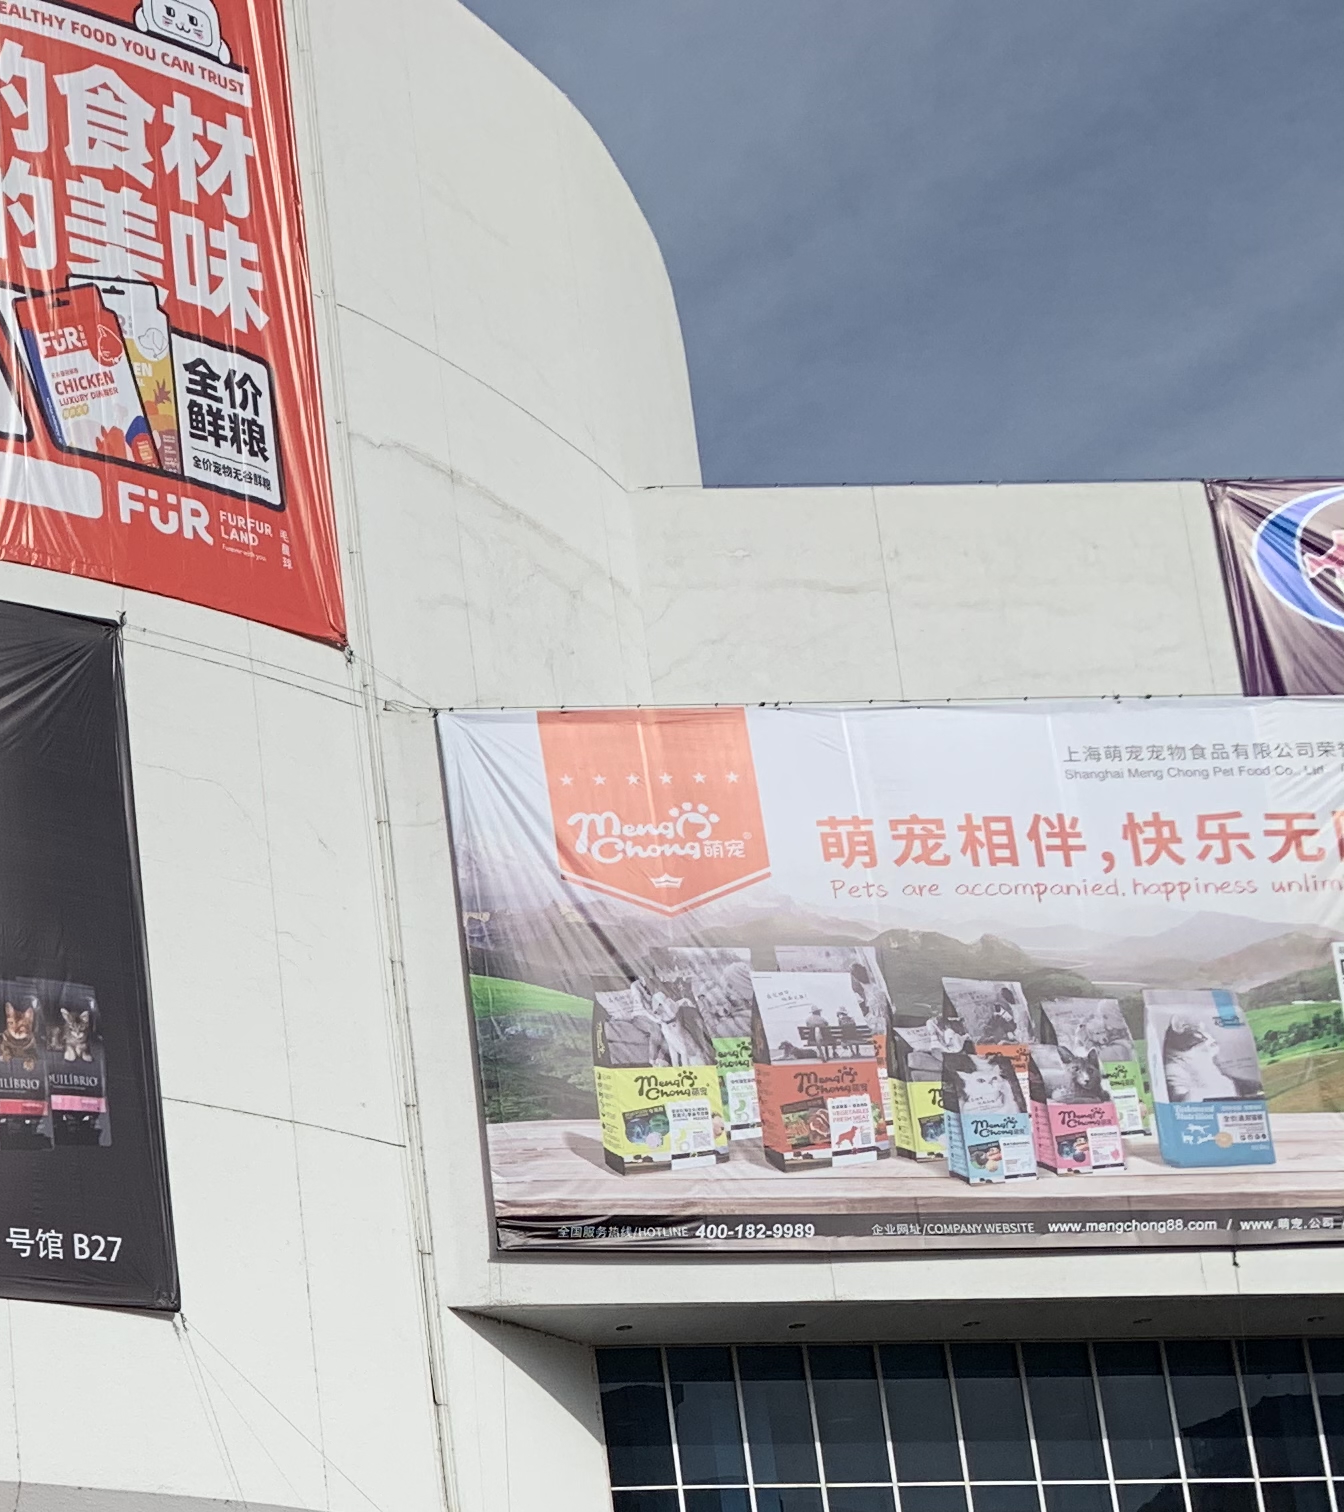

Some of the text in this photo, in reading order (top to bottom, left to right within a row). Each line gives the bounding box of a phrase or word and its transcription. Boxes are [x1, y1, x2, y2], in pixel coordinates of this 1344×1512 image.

[71, 20, 117, 48] FOOD
[121, 36, 157, 61] YOU
[161, 51, 194, 76] CAN
[199, 65, 245, 96] TRUST
[55, 370, 115, 396] CHICKEN
[183, 357, 262, 418] 全价
[59, 387, 119, 407] LUXURY DINNER
[187, 398, 270, 463] 鲜粮
[220, 510, 273, 537] FURFUR
[220, 525, 259, 547] LAND
[1063, 742, 1344, 763] 上海萌宠宠物食品有限公司荣
[1064, 765, 1272, 782] Shanghai Meng Chong Pet Food
[567, 811, 678, 854] Meng
[816, 810, 1344, 873] 萌宠相伴,快乐无
[591, 837, 746, 864] Chong 萌宠
[831, 879, 889, 898] Pets
[902, 880, 943, 897] are
[1133, 876, 1259, 903] happiness
[695, 1223, 815, 1239] 400-182-9989
[1048, 1218, 1217, 1234] www.mengchong88.com
[5, 1226, 64, 1261] 号馆
[73, 1233, 123, 1264] B27
